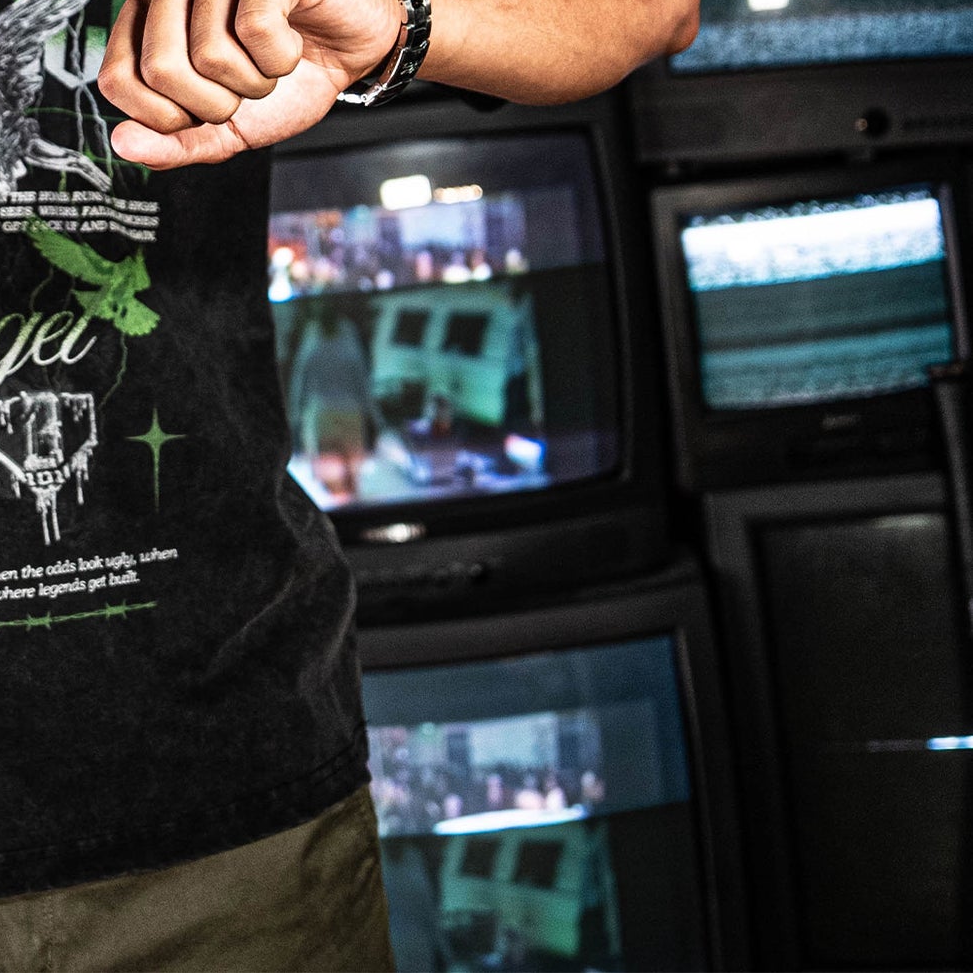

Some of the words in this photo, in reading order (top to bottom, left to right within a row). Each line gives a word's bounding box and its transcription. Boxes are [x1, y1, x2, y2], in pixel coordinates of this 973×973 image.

[21, 565, 44, 579] the
[45, 560, 77, 576] odds
[78, 556, 104, 572] look
[139, 547, 178, 563] when
[38, 577, 87, 598] legends
[88, 575, 106, 593] get
